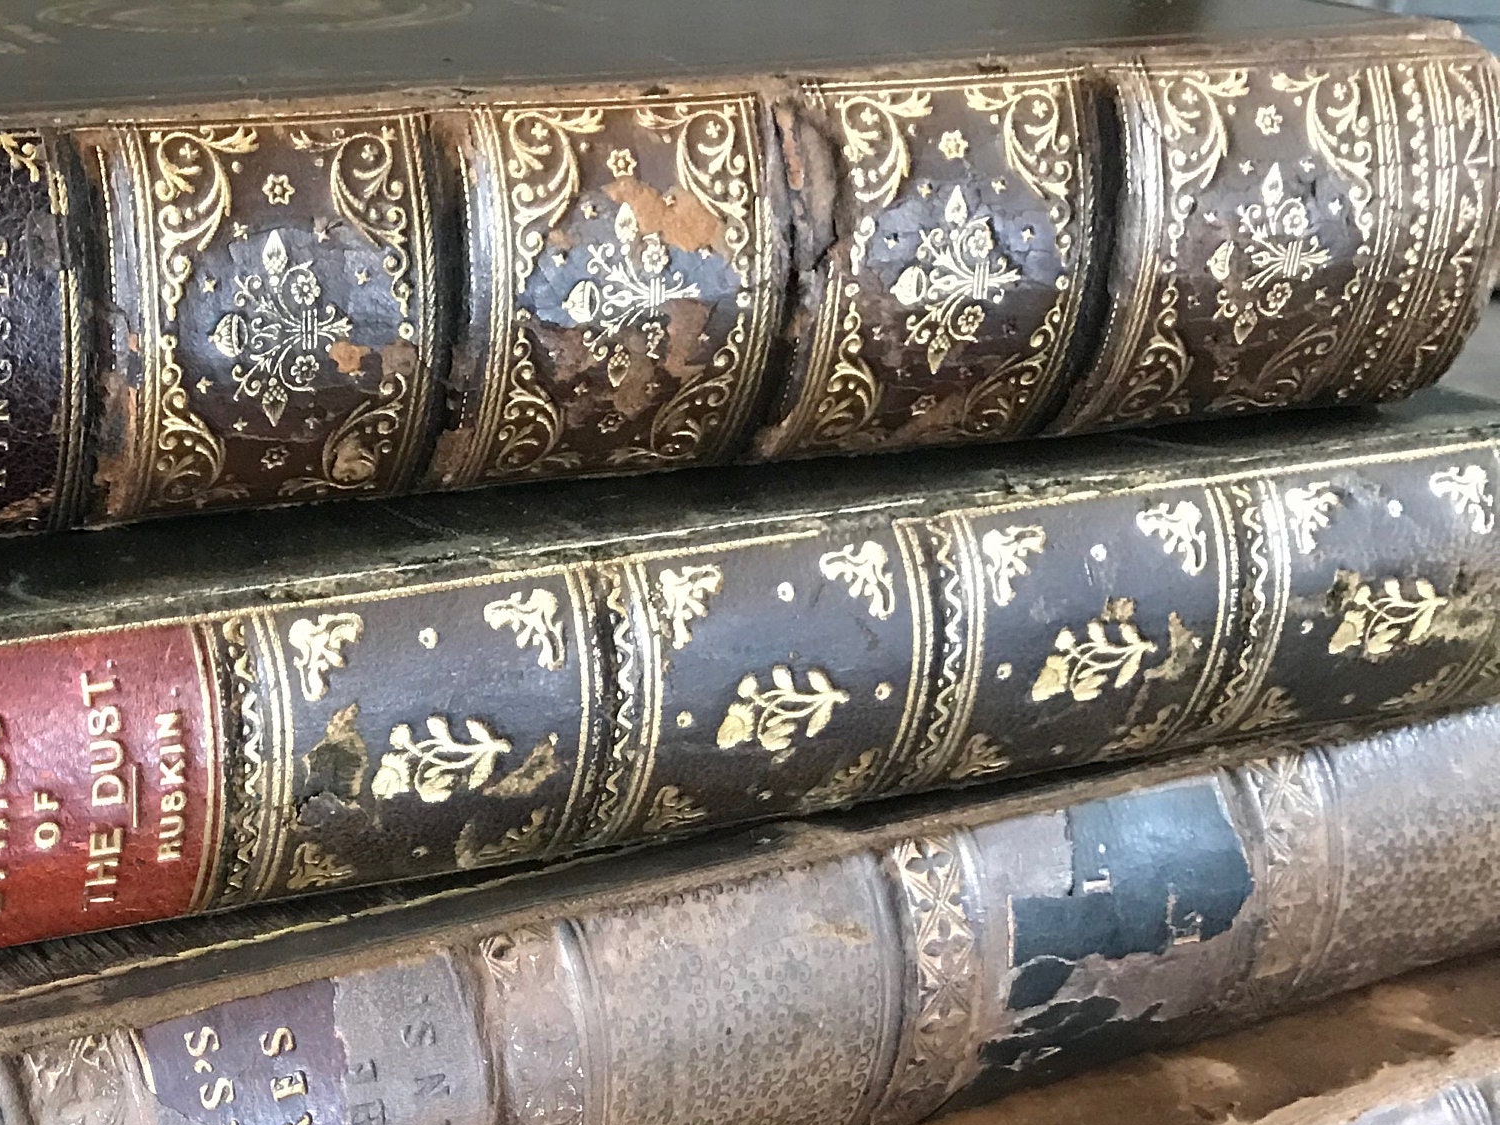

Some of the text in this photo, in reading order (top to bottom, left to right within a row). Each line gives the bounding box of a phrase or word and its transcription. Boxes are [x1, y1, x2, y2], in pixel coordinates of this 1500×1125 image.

[33, 791, 61, 850] OF
[80, 659, 127, 912] THE DUST.
